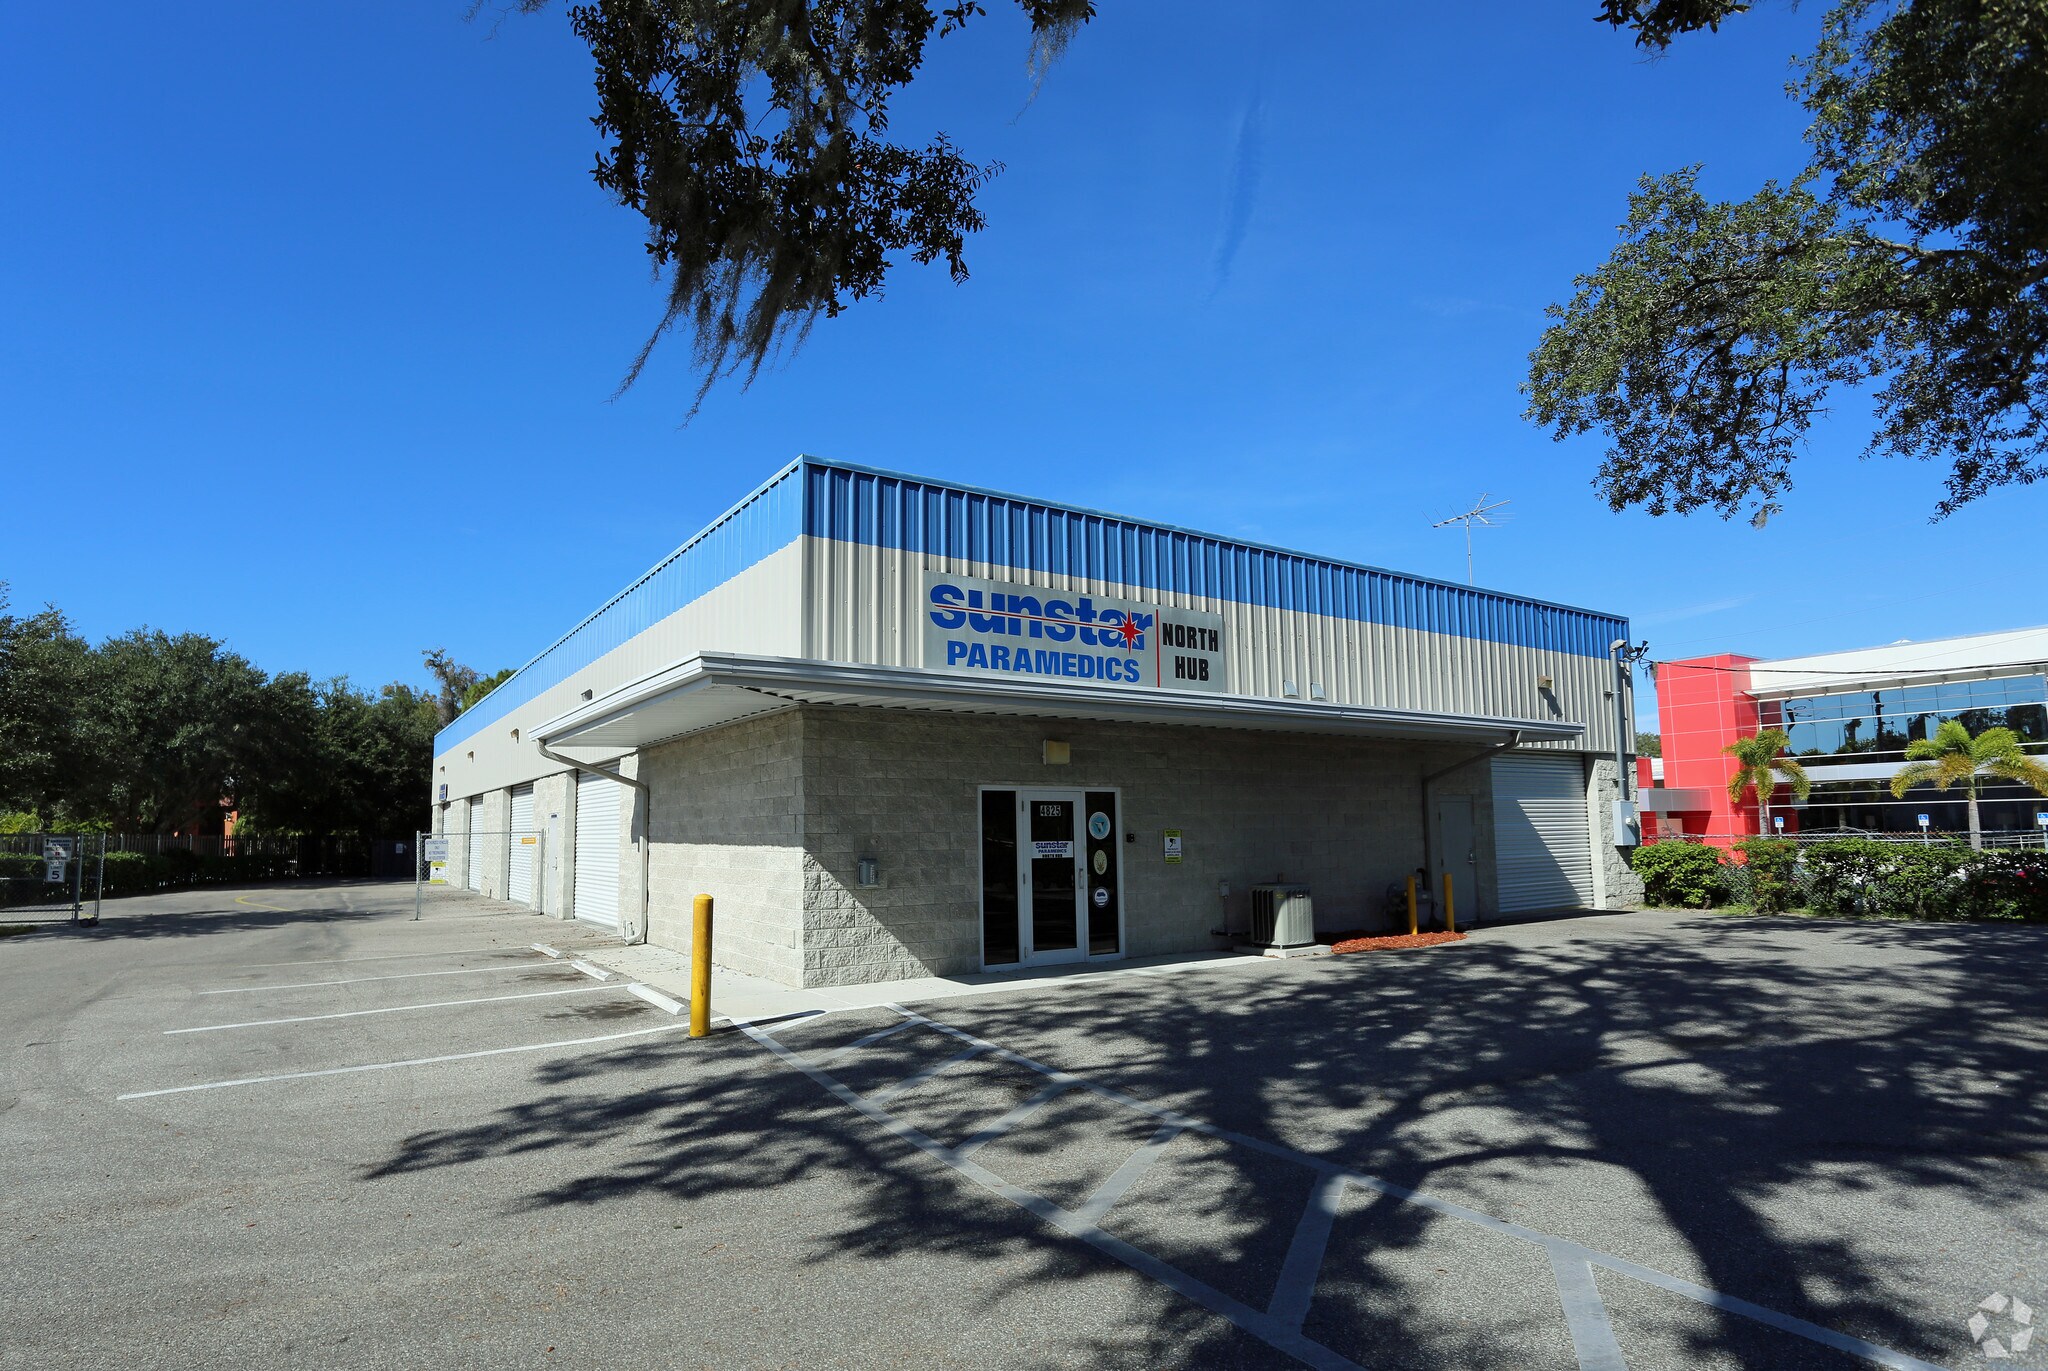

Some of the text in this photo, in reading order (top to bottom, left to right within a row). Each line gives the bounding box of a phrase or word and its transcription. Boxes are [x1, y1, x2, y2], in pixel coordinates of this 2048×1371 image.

[929, 584, 1153, 651] sunstar
[1162, 622, 1218, 652] NORTH
[947, 639, 1140, 683] PARAMEDICS
[1175, 655, 1209, 682] HUB
[1040, 805, 1061, 817] 4825
[52, 870, 60, 879] 5
